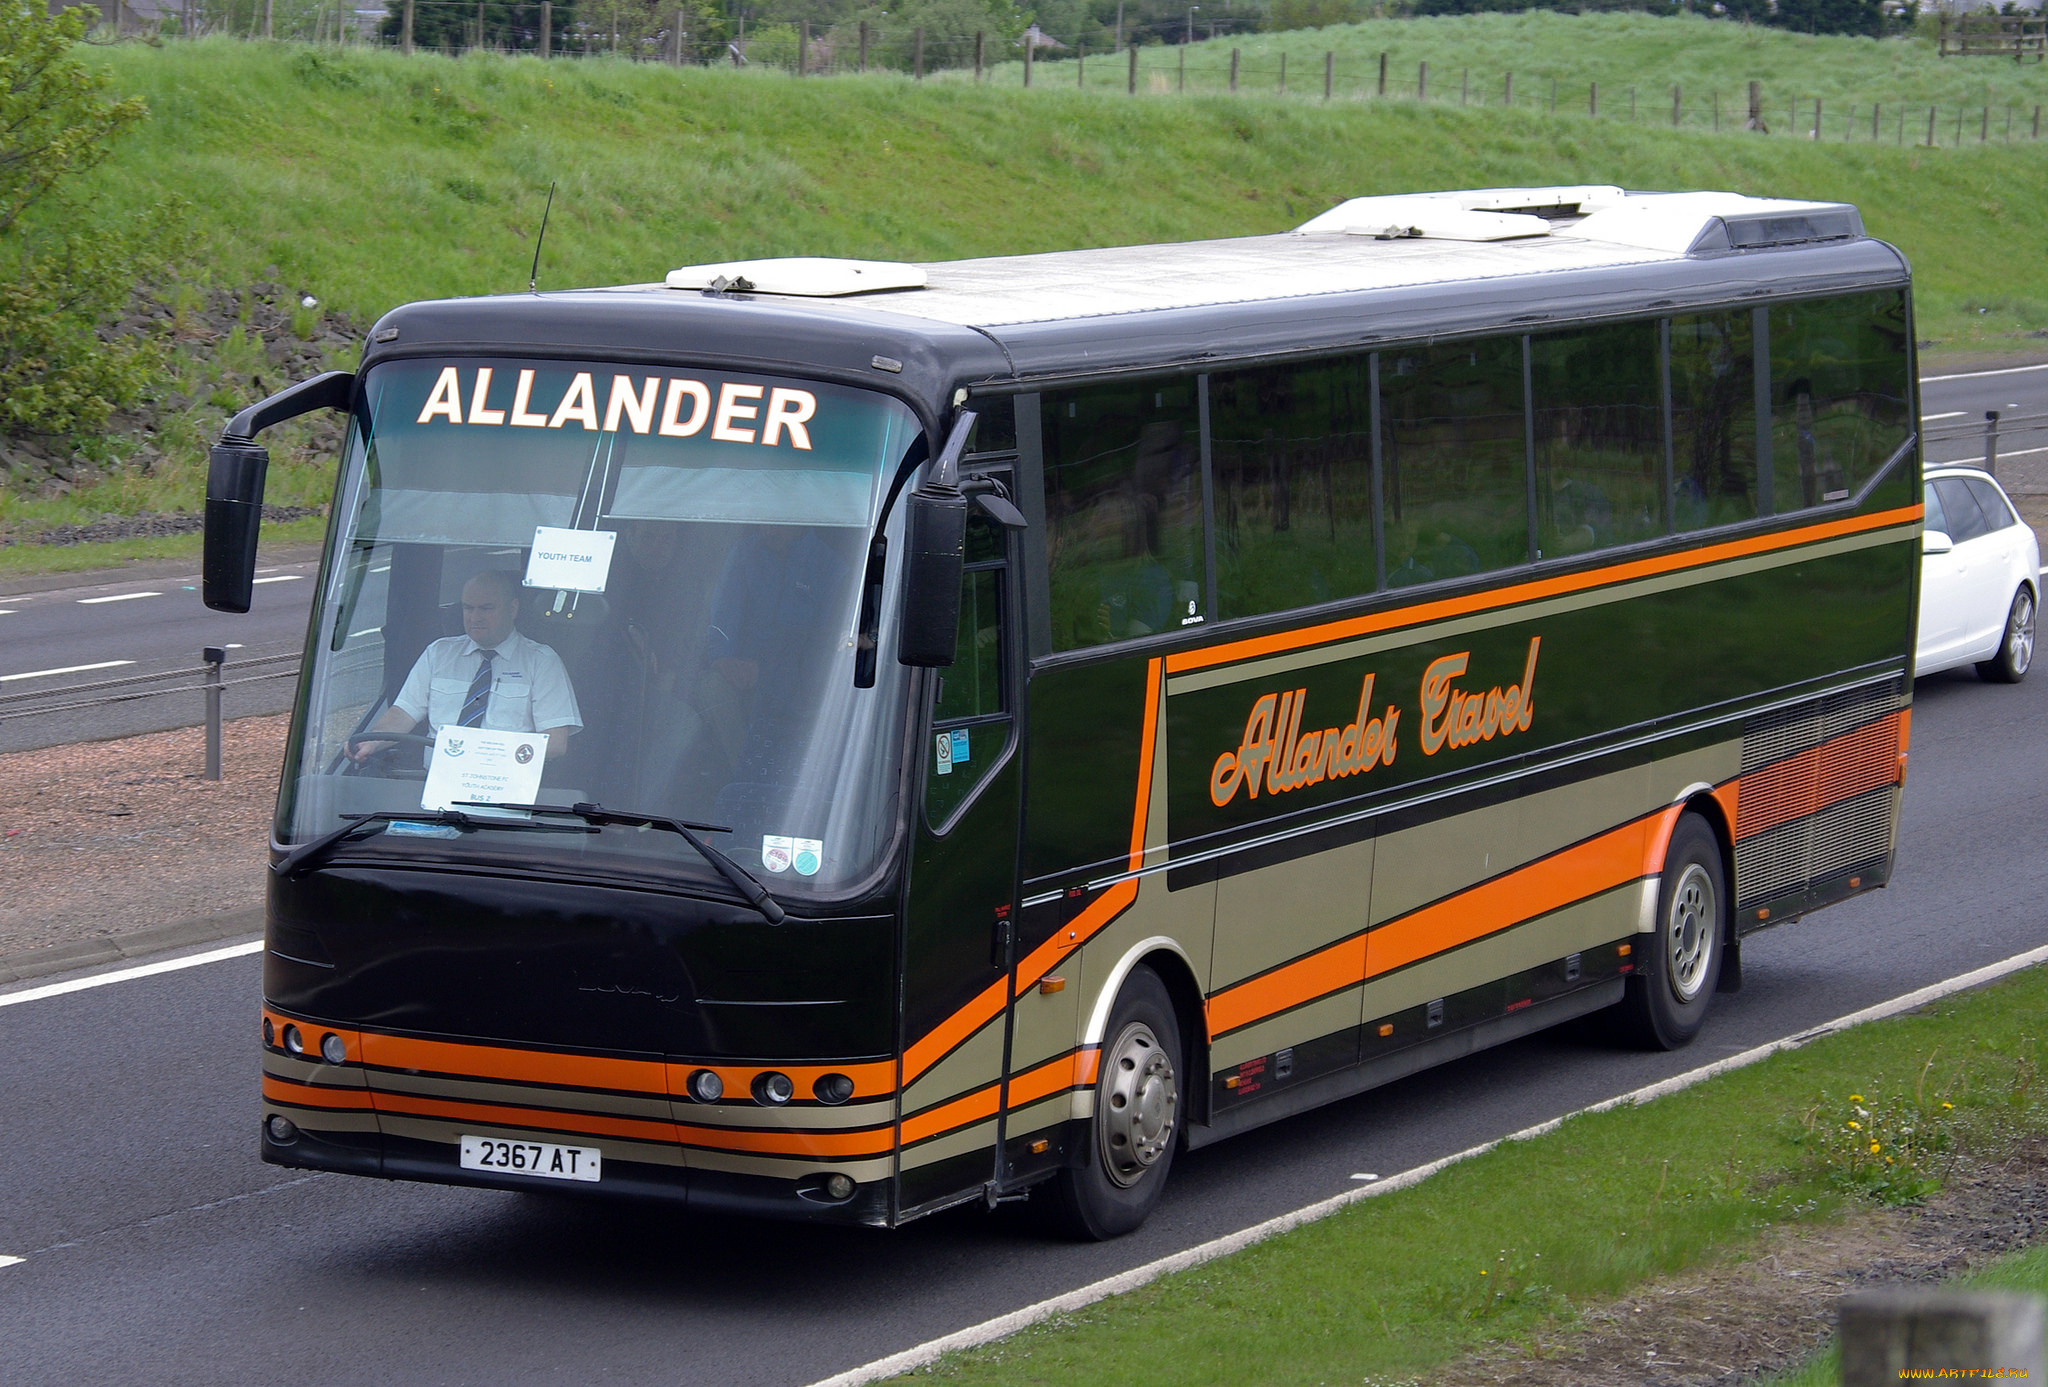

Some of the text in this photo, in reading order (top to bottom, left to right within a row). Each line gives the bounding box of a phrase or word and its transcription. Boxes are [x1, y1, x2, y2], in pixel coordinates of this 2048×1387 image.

[416, 366, 818, 450] ALLANDER
[538, 551, 592, 563] YOUTH TEAM
[1181, 615, 1204, 626] BOVA
[1210, 636, 1541, 807] Allander Travel
[470, 793, 485, 801] BUS
[480, 1141, 581, 1174] 2367 AT
